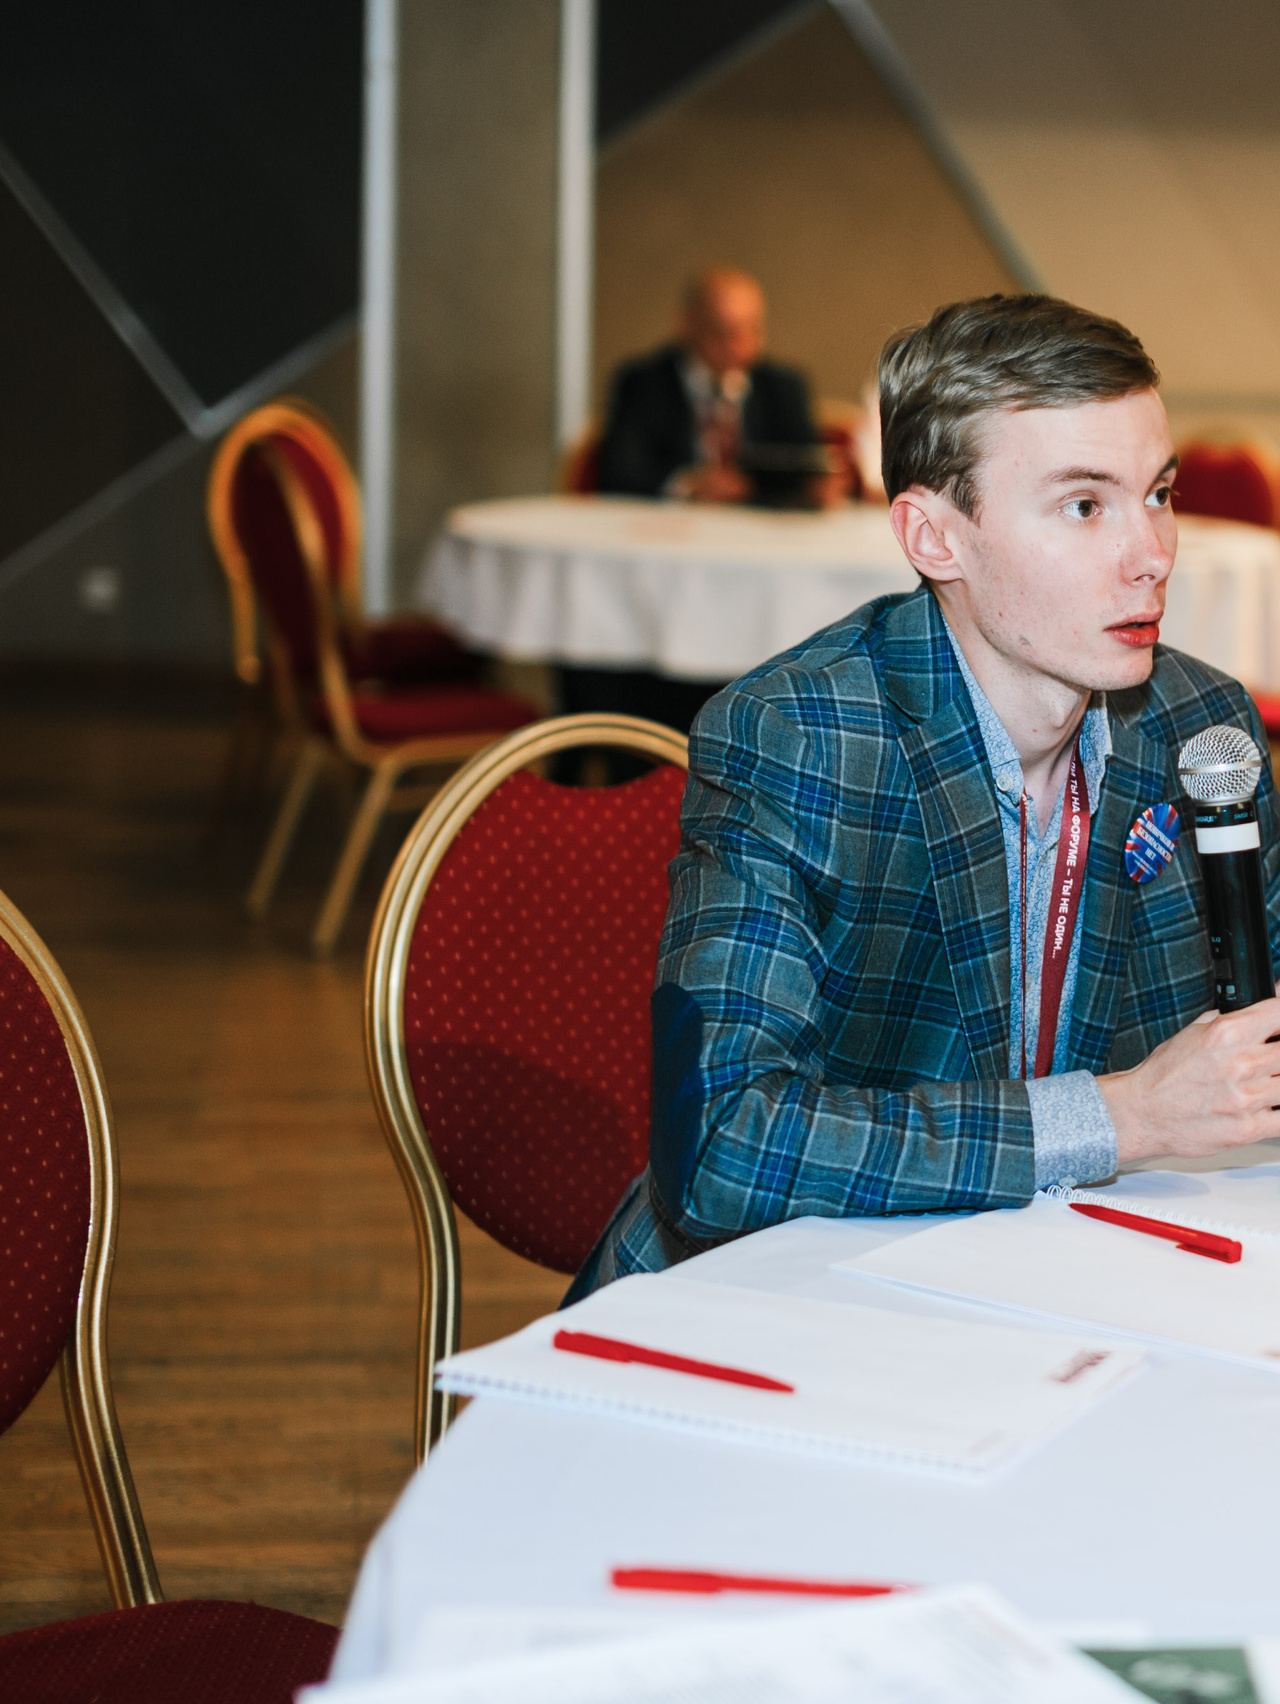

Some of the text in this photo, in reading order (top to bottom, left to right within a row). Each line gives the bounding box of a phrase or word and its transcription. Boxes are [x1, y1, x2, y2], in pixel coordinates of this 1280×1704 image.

[1070, 780, 1079, 795] ТЫ
[1071, 796, 1081, 813] НА
[1066, 815, 1081, 867] ФОРУМЕ
[1144, 847, 1157, 861] НЕТ
[1061, 879, 1074, 896] ТЫ
[1058, 897, 1070, 914] НЕ
[1052, 915, 1067, 959] ОДИН...
